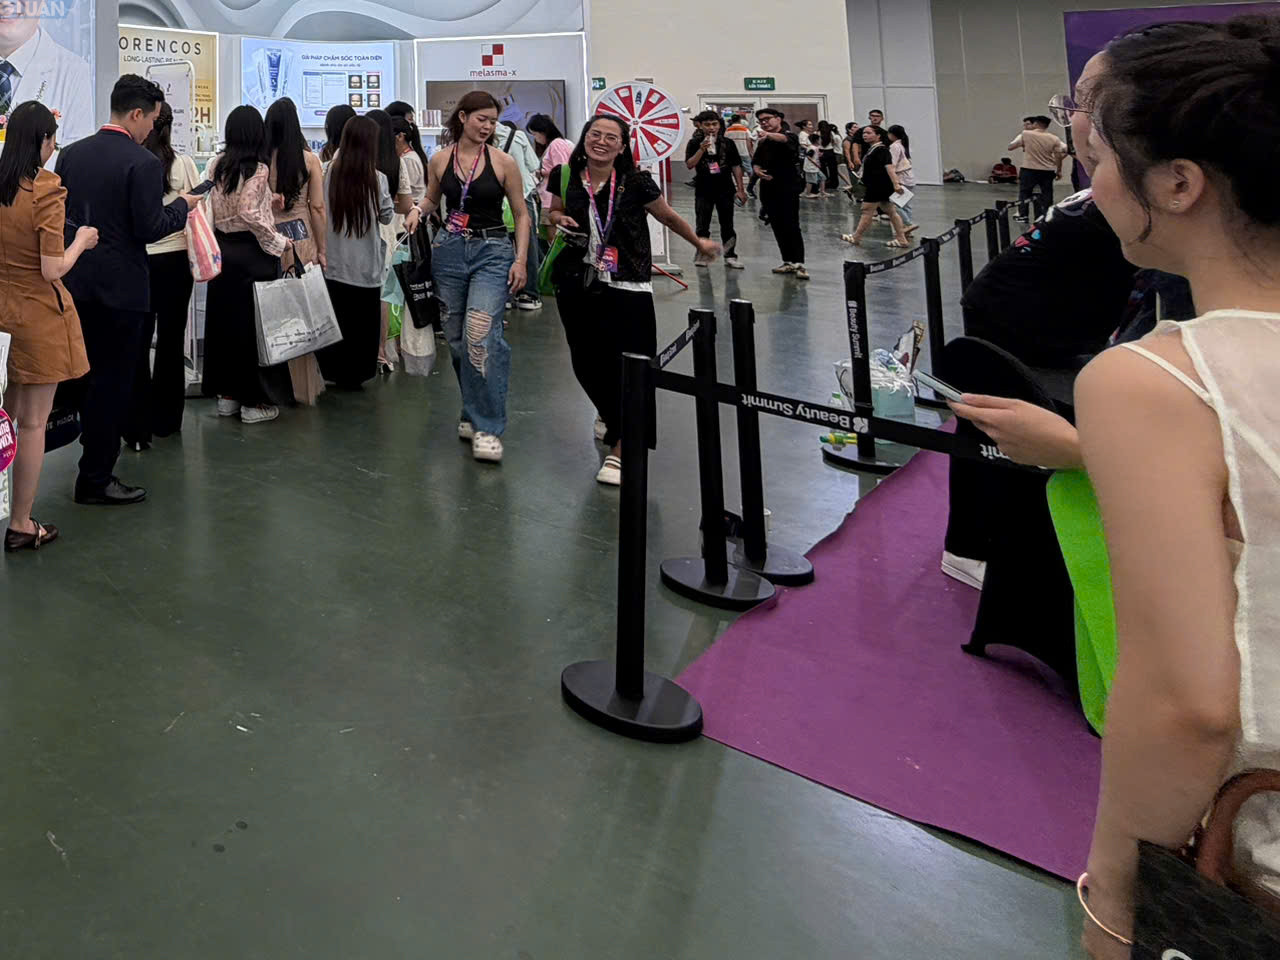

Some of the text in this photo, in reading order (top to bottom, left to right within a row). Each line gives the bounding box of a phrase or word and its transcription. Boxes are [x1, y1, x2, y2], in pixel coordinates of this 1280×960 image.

[118, 36, 202, 56] ORENCOS
[469, 68, 518, 77] melasma-x
[848, 307, 863, 359] Beauty Summit
[741, 393, 850, 428] Beauty Summit
